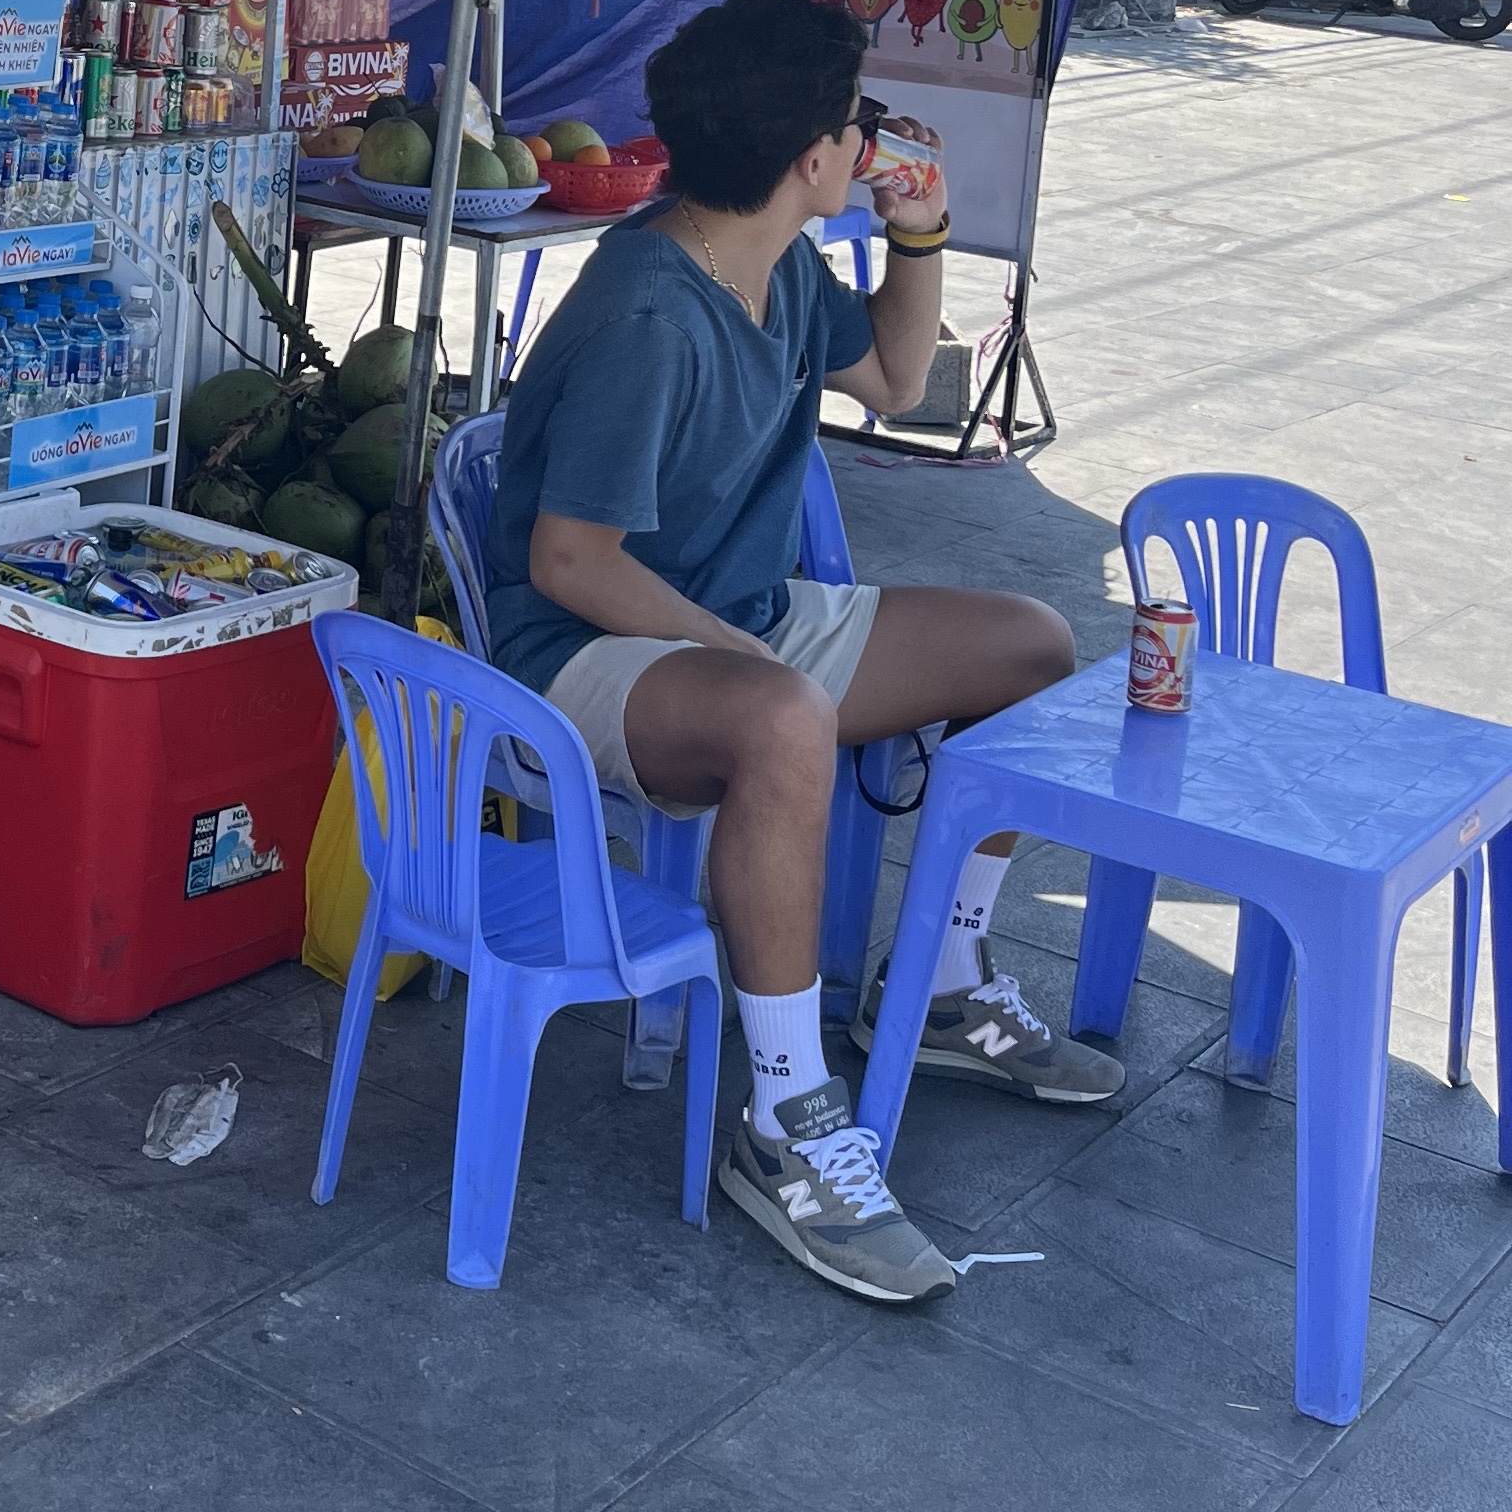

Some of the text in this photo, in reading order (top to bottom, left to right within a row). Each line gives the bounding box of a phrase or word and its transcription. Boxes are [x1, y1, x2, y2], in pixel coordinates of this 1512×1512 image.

[27, 24, 59, 36] NGAY!
[13, 39, 45, 53] NHIÊN
[7, 54, 38, 70] KHIẾT
[327, 50, 393, 77] BIVINA
[2, 245, 41, 268] laVie
[41, 247, 75, 262] NGAY!
[14, 366, 46, 382] laVi
[31, 429, 136, 464] UỐNG laVie NGAY!
[1133, 649, 1171, 671] VINA
[193, 845, 213, 858] 1947
[964, 1020, 1019, 1058] N
[803, 1093, 829, 1115] 998
[814, 1105, 846, 1126] balance
[777, 1178, 823, 1222] N
